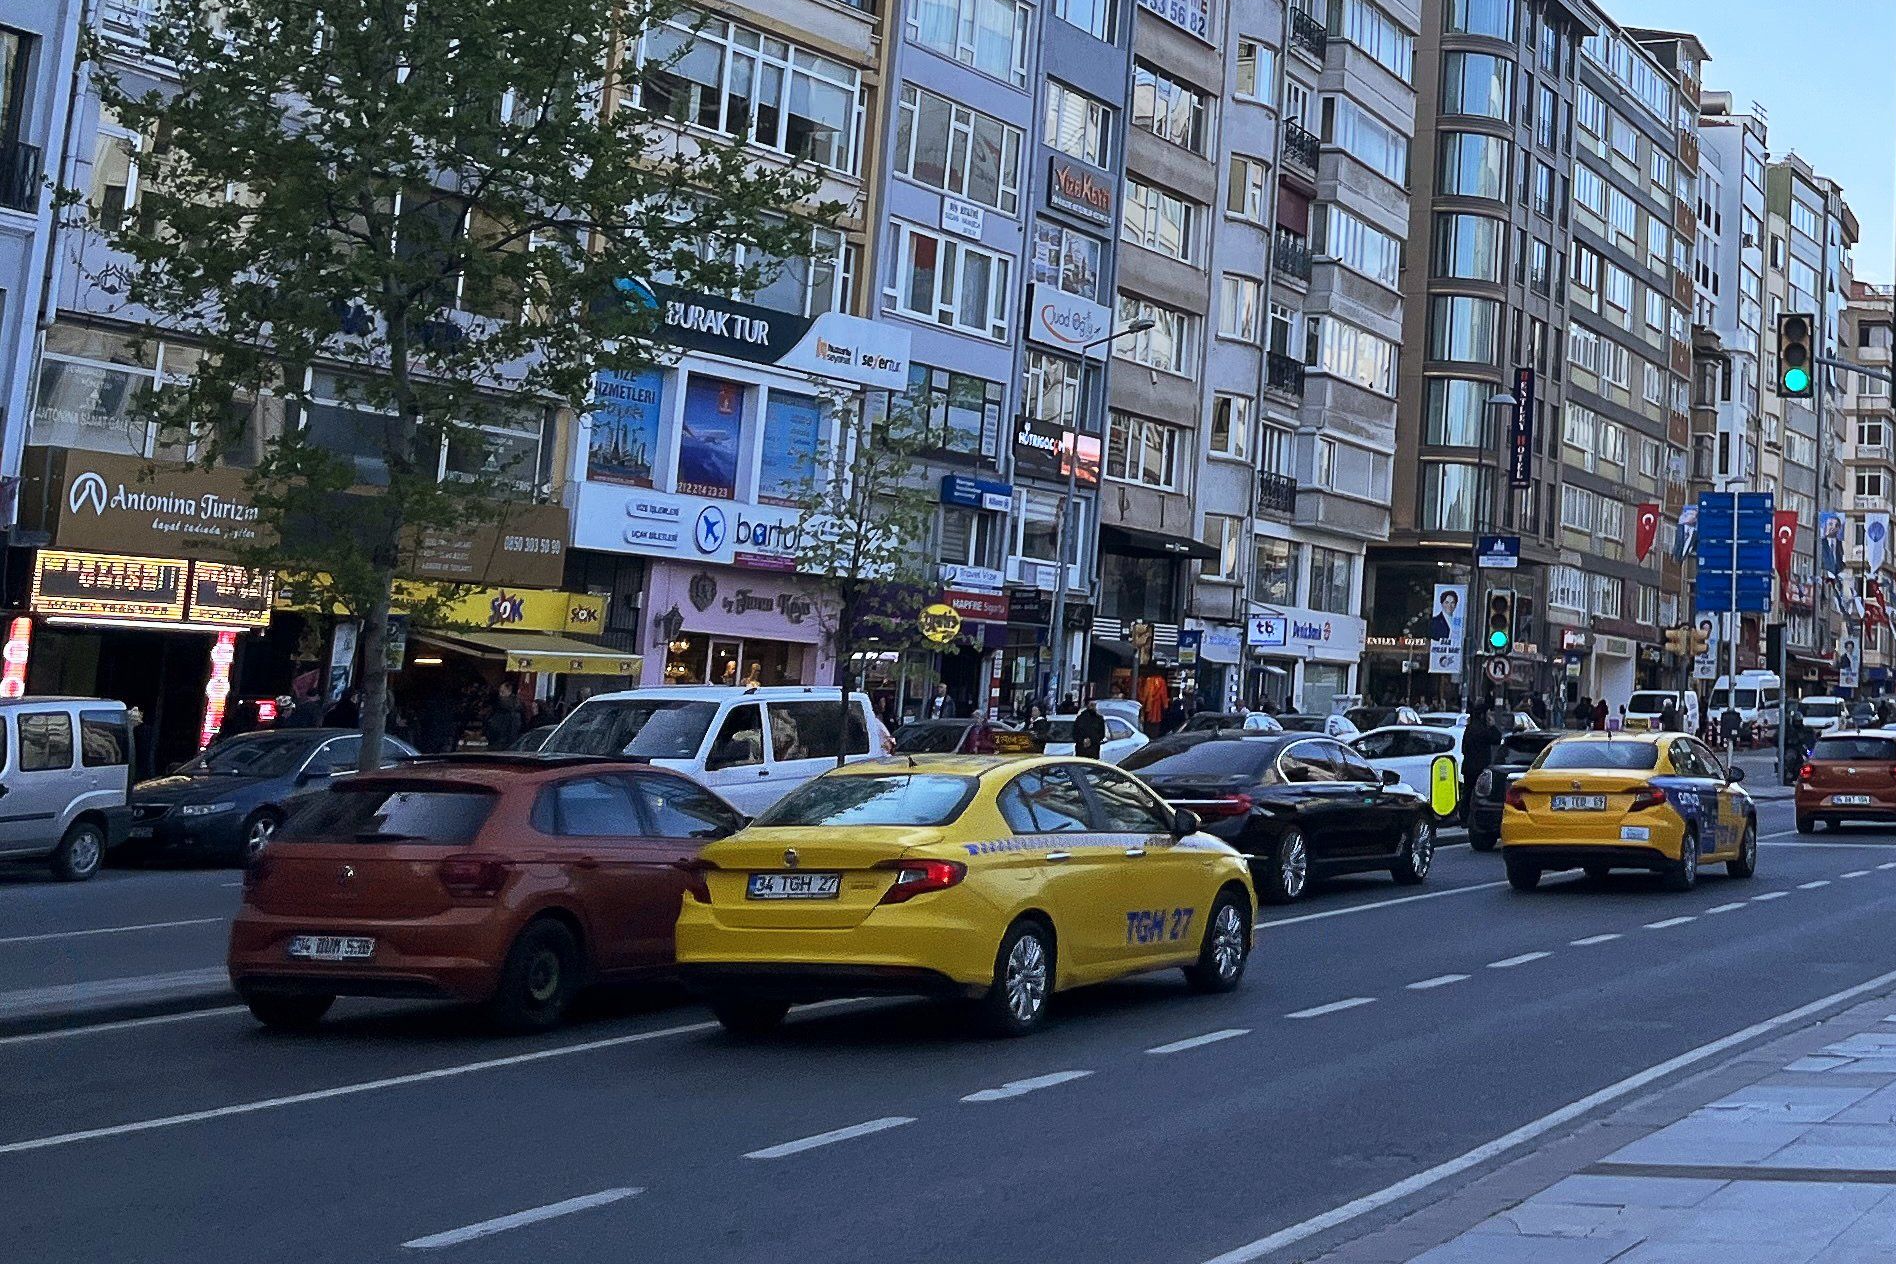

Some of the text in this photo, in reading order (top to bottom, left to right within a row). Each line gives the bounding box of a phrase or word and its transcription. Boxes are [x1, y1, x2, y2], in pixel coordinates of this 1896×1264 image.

[734, 315, 770, 347] TUR
[110, 484, 196, 516] Antonina
[735, 512, 801, 549] bartu
[782, 876, 812, 892] TGH
[1126, 907, 1195, 944] TGH 27
